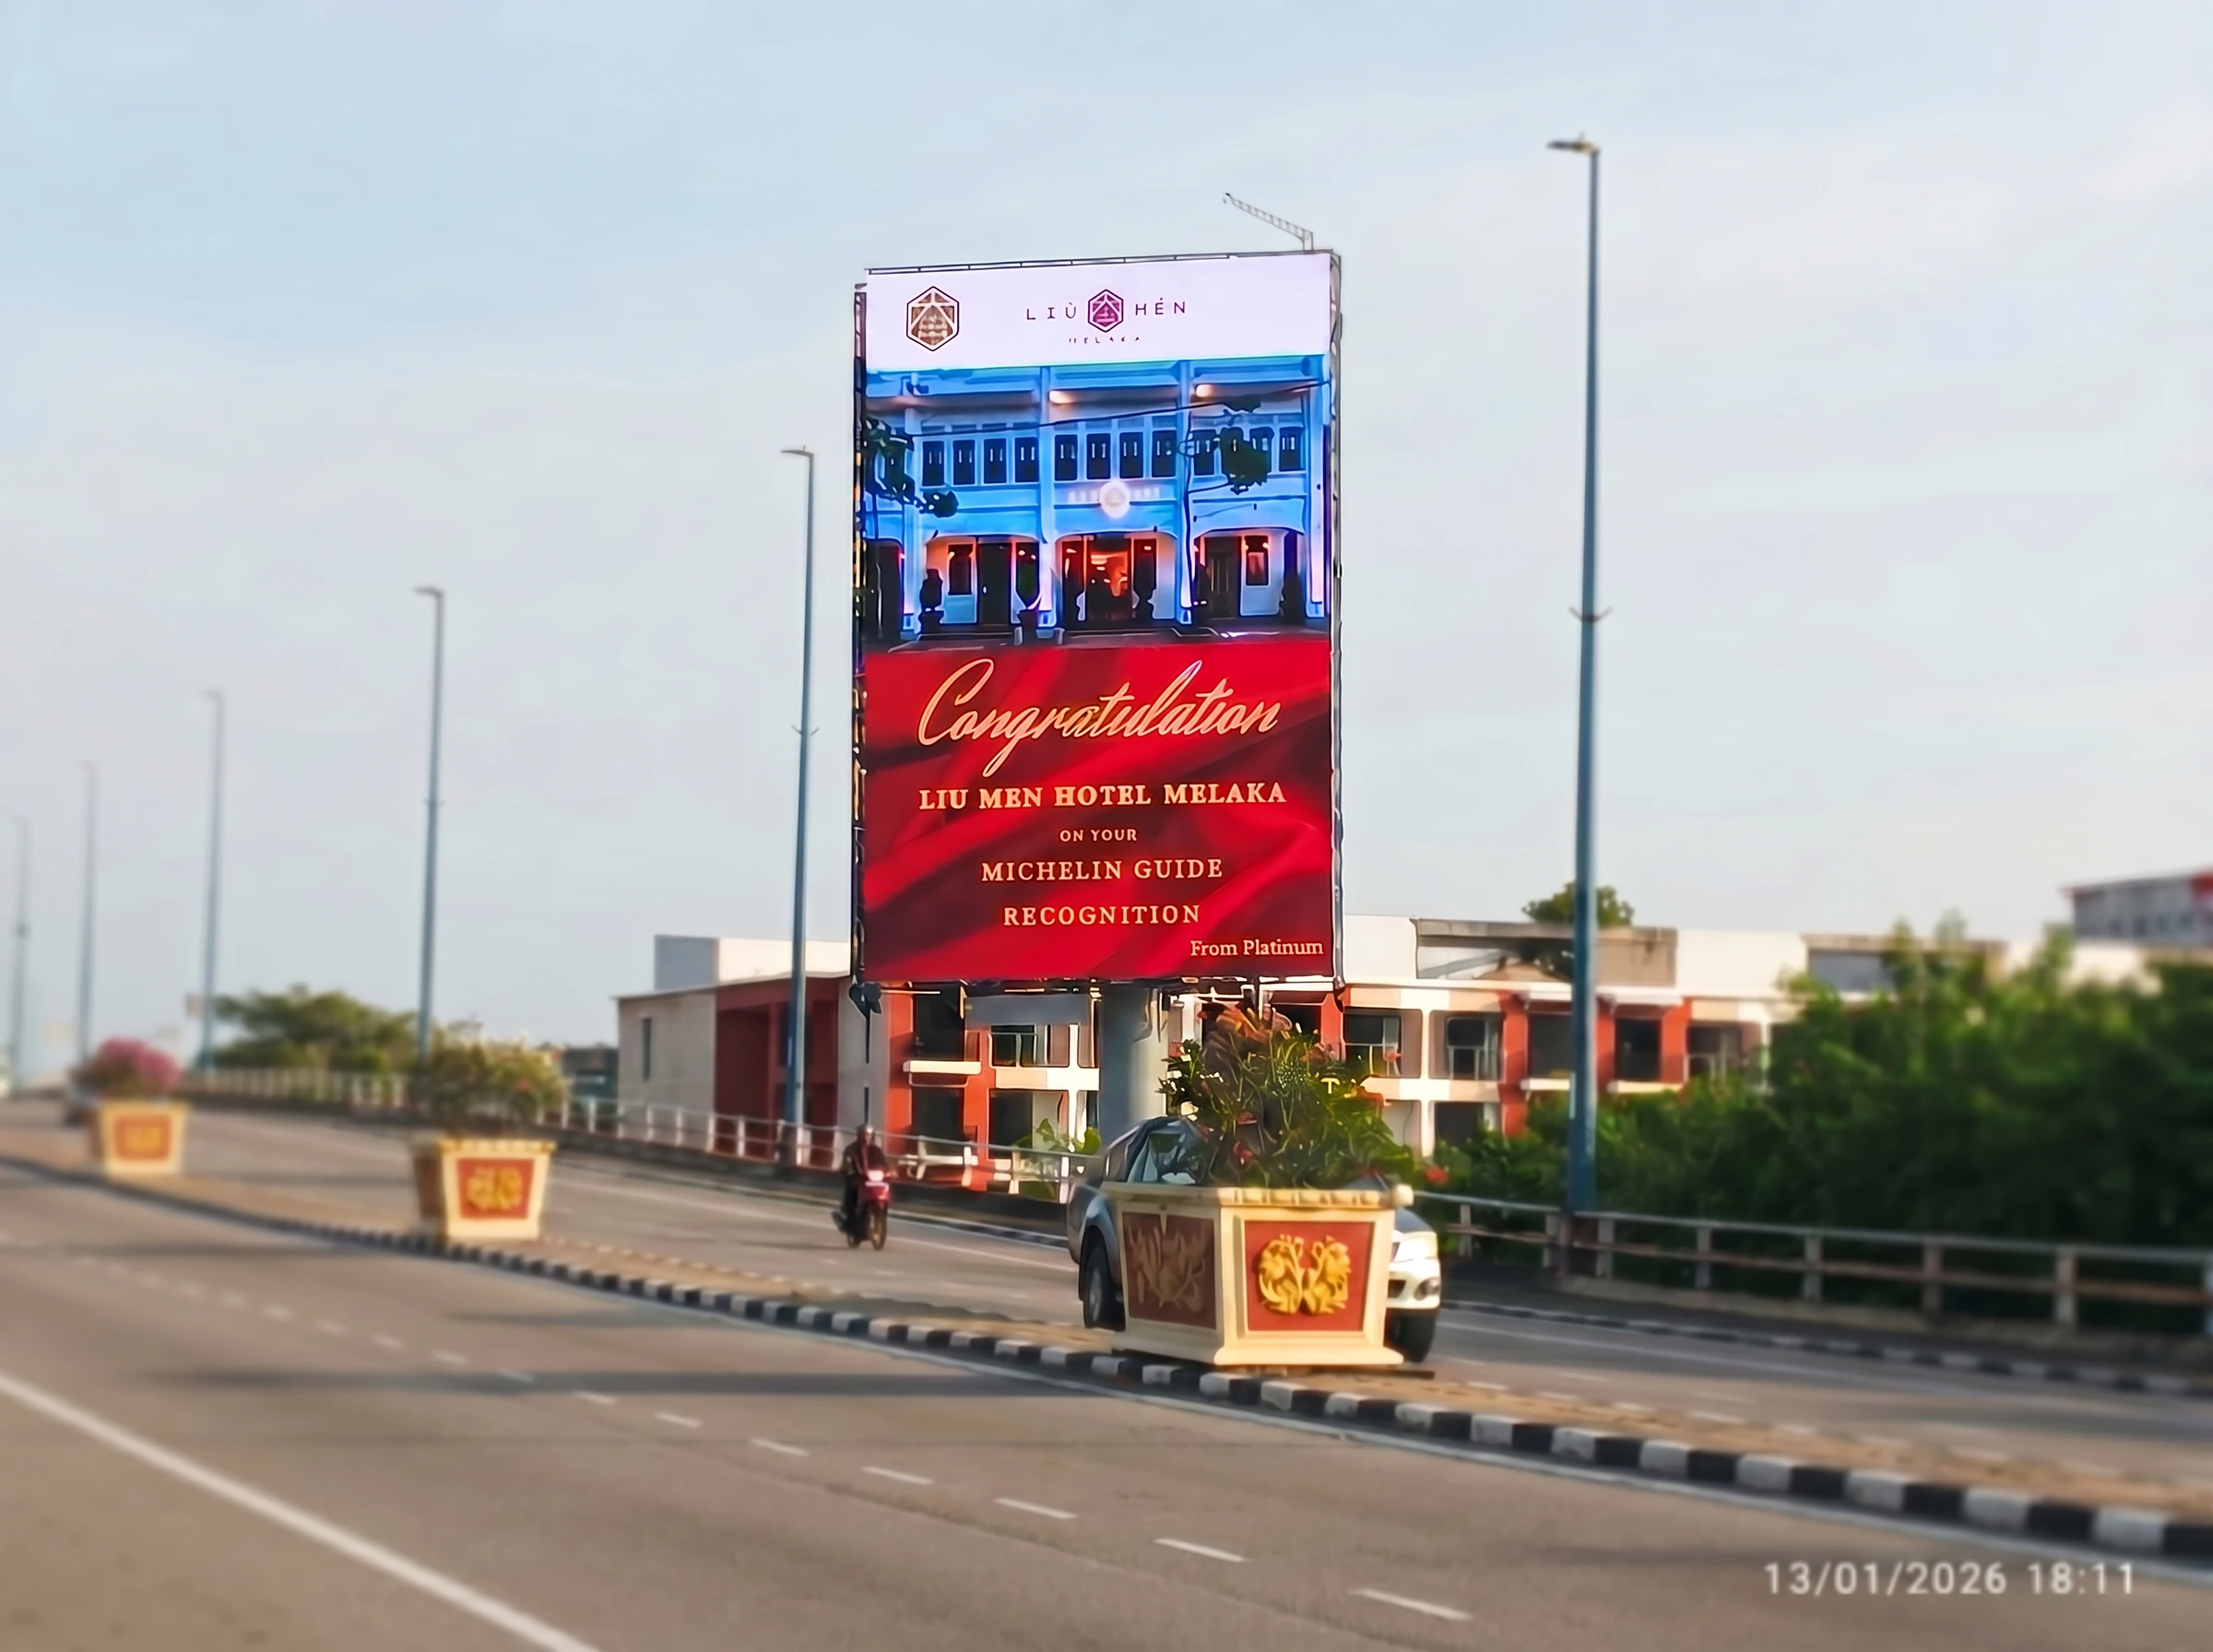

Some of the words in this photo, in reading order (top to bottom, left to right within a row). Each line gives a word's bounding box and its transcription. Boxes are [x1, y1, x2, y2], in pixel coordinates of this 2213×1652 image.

[917, 658, 1282, 777] Congratulation
[918, 788, 969, 810] LIU
[978, 786, 1044, 809] MEN
[1054, 785, 1152, 807] HOTEL
[1164, 782, 1287, 805] MELAKA
[1059, 830, 1083, 843] ON
[1090, 829, 1137, 842] YOUR
[981, 860, 1122, 881] MICHELIN
[1134, 858, 1223, 879] GUIDE
[1003, 904, 1200, 926] RECOGNITION
[1190, 939, 1238, 956] From
[1243, 938, 1324, 956] Platinum
